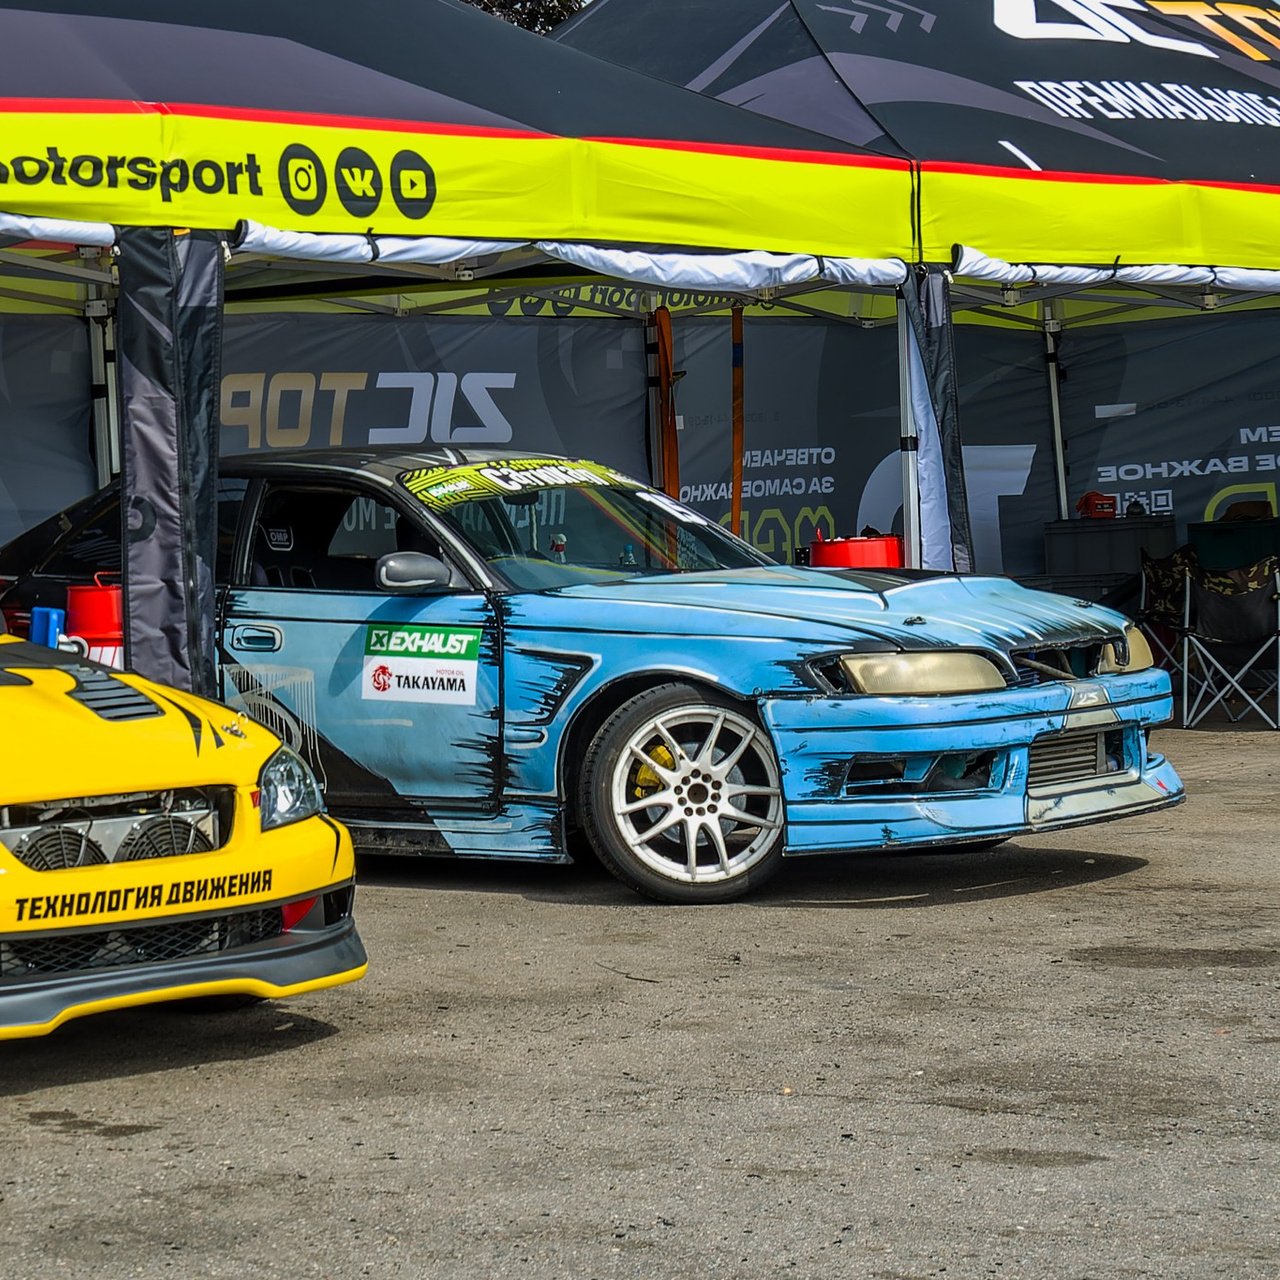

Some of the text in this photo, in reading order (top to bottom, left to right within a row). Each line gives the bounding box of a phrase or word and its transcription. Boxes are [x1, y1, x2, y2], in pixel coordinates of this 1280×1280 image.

[388, 631, 474, 655] EXHAUST
[395, 674, 467, 693] TAKAYAMA
[15, 868, 273, 923] ТЕХНОЛОГИЯ ДВИЖЕНИЯ
